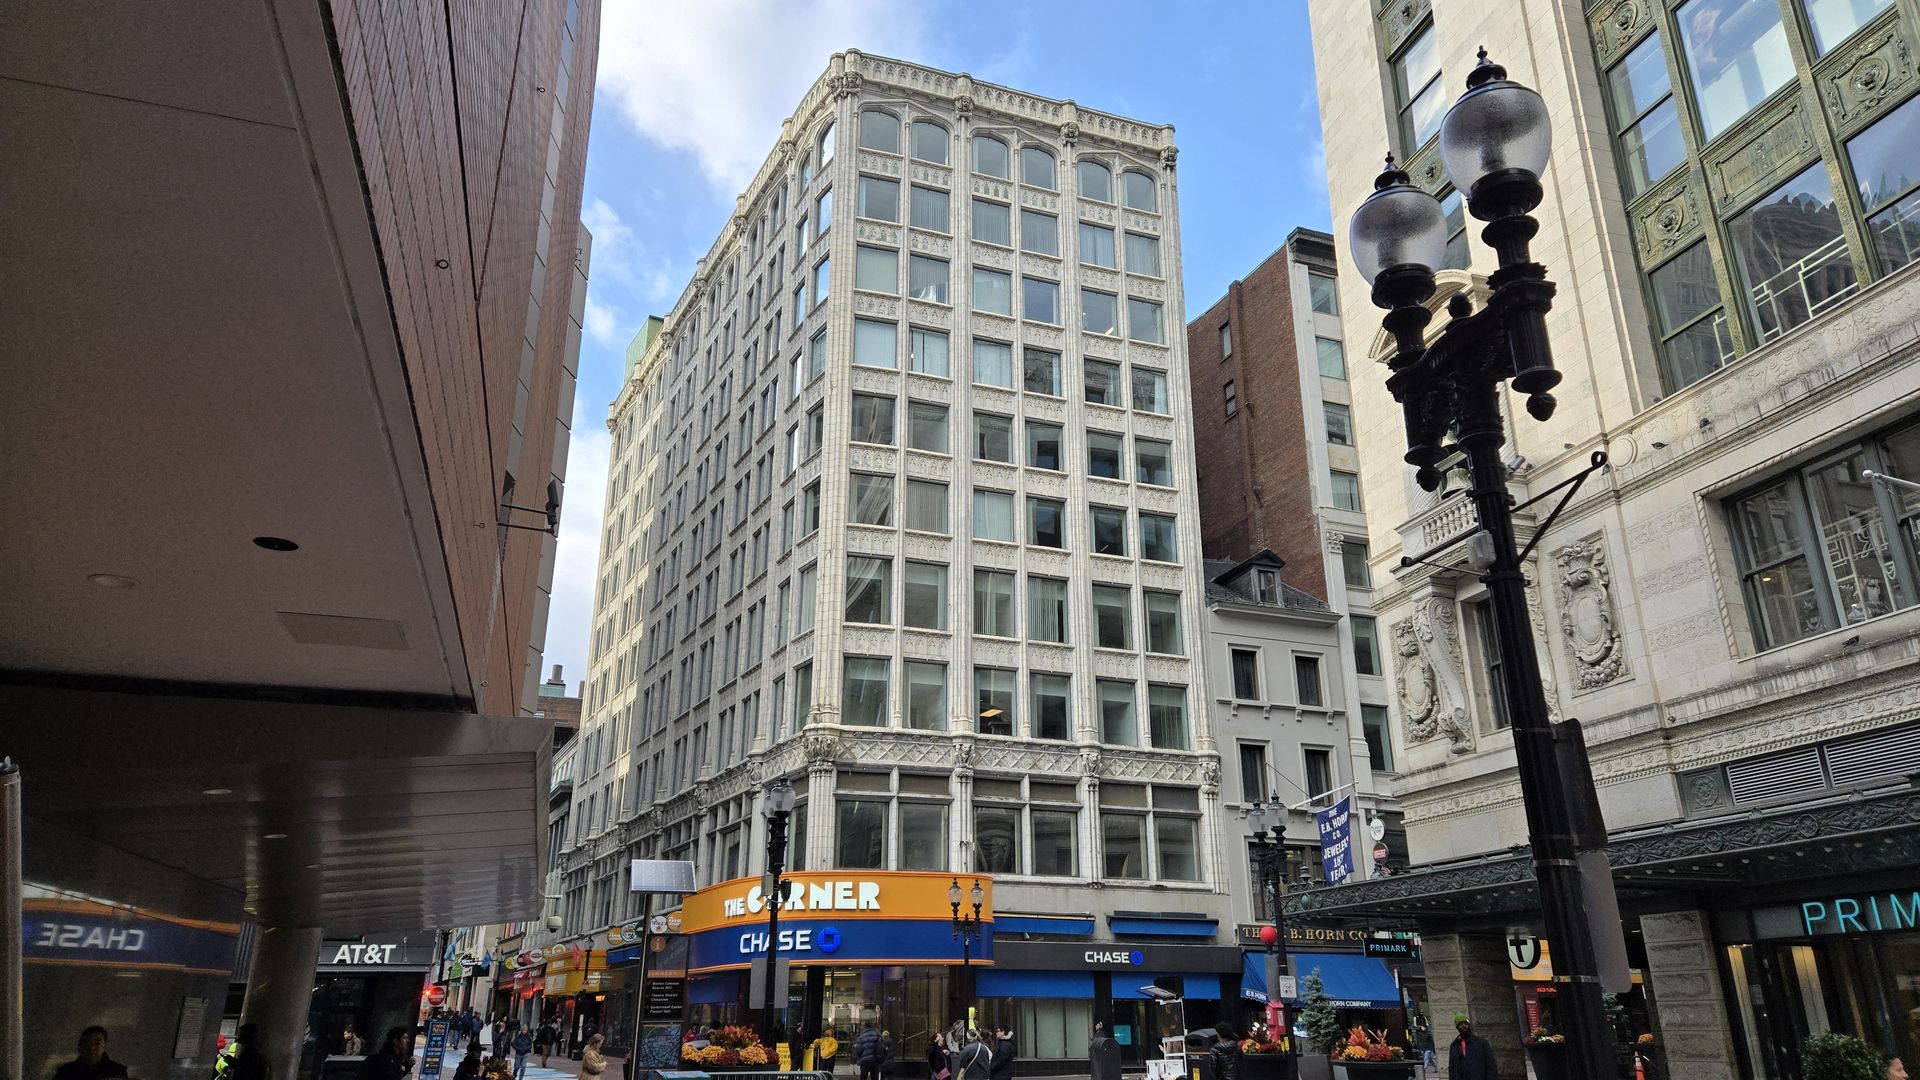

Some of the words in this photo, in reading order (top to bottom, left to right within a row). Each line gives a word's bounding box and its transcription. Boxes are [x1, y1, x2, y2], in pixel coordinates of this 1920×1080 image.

[1328, 807, 1337, 818] THE
[724, 897, 745, 917] THE
[747, 881, 881, 914] CRNER
[1802, 892, 1920, 936] PRIM
[1289, 928, 1302, 939] B.
[1305, 928, 1344, 941] HORN
[332, 943, 397, 965] AT&T
[1369, 943, 1407, 953] PRIMARK
[1084, 951, 1130, 964] CHASE
